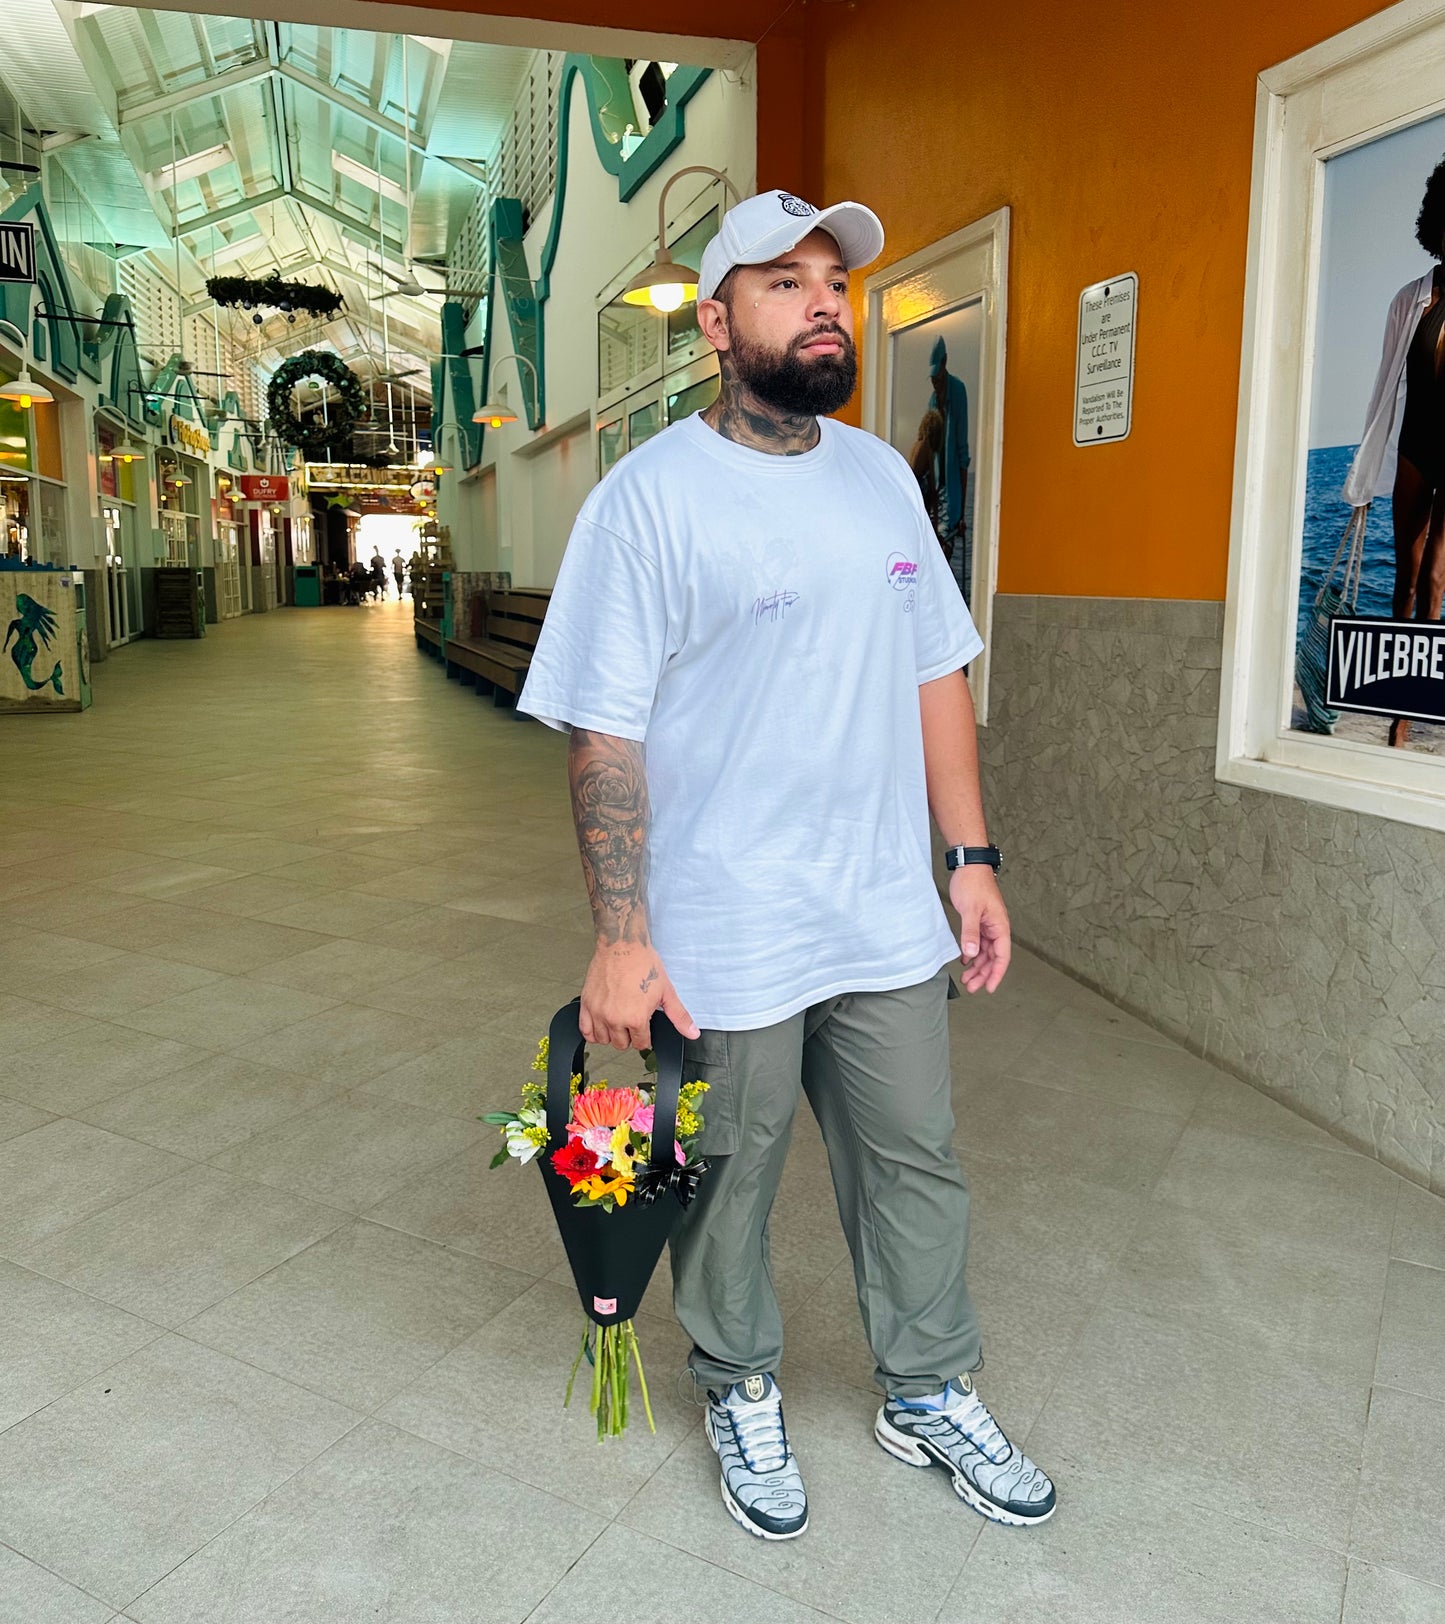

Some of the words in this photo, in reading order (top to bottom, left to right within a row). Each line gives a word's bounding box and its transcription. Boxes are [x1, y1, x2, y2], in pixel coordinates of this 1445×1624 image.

[1085, 300, 1103, 313] These
[1103, 290, 1130, 308] Premises
[1101, 313, 1111, 324] are
[1082, 332, 1098, 345] Under
[1099, 322, 1130, 340] Permanent
[1109, 340, 1119, 353] TV
[1086, 358, 1122, 375] Surveillance
[1116, 389, 1124, 398] Be
[1082, 404, 1105, 415] Reported
[1105, 402, 1112, 411] To
[1112, 400, 1123, 409] The
[1079, 415, 1095, 426] Proper
[252, 488, 277, 496] DUFRY
